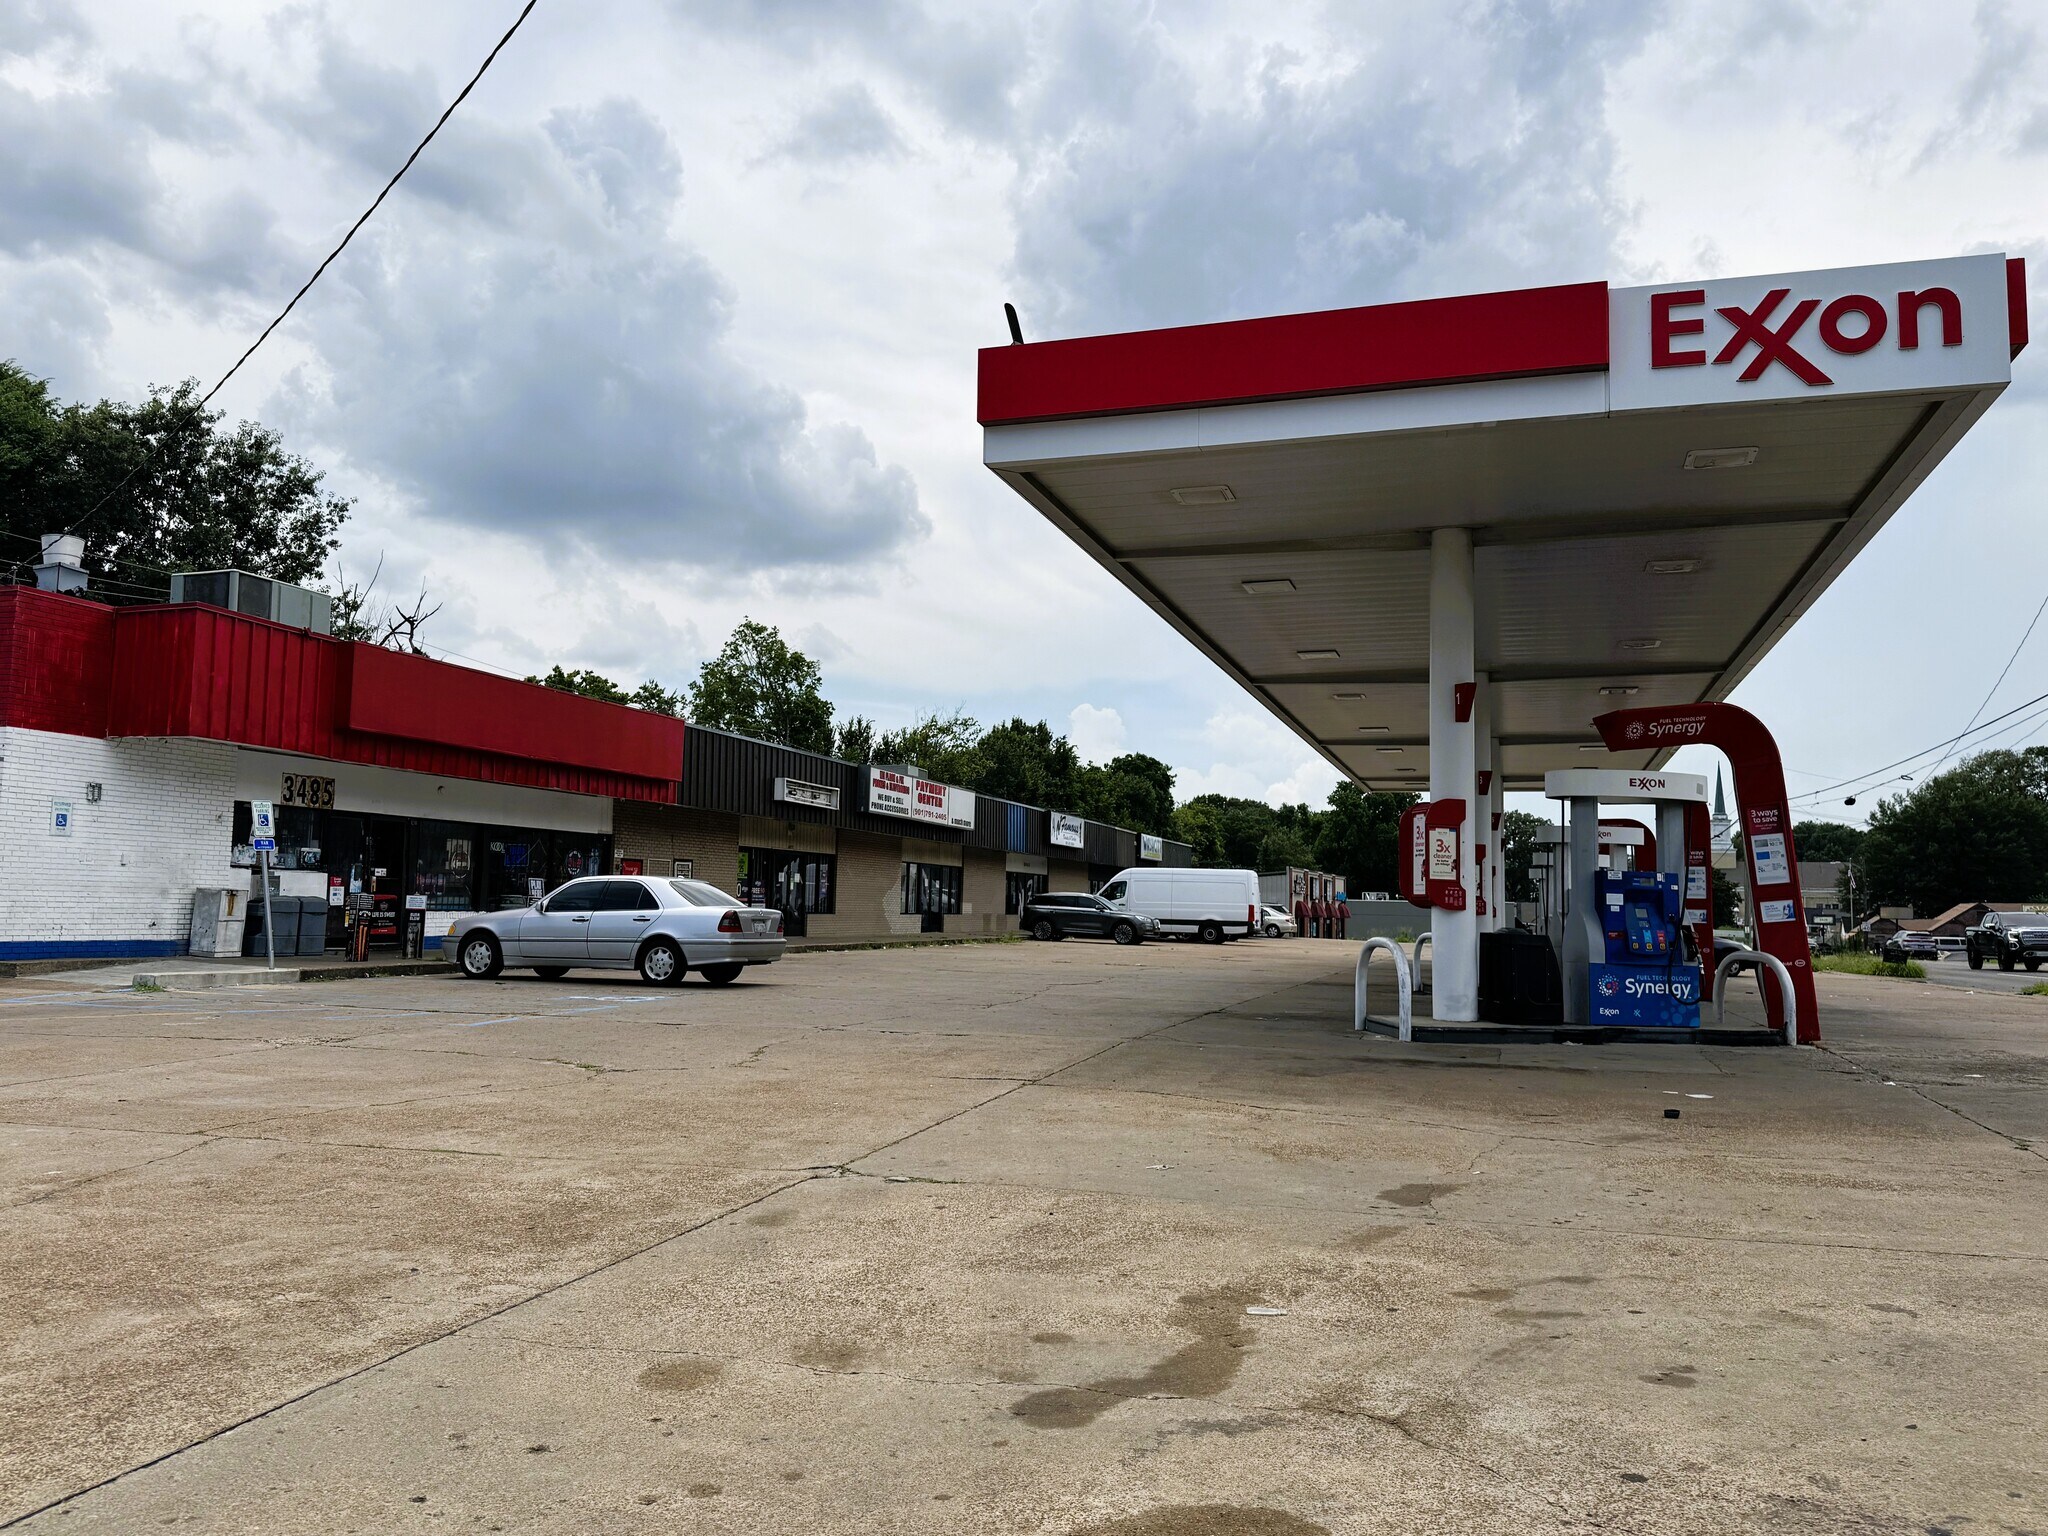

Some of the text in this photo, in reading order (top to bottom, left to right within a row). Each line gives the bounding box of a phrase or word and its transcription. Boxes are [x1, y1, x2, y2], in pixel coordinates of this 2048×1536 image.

[1651, 287, 1962, 386] Exxon
[1456, 693, 1460, 704] 1
[1648, 722, 1705, 738] Synergy
[282, 775, 333, 806] 3485
[916, 780, 946, 797] PAYMENT
[1629, 777, 1666, 791] EXXON
[877, 793, 884, 801] WE
[884, 794, 892, 803] BUY
[895, 797, 904, 805] SELL
[917, 793, 943, 808] CENTER
[871, 801, 909, 815] PHONE ACCESSORIES
[1756, 809, 1778, 817] ways
[1416, 826, 1424, 840] 3x
[1436, 839, 1451, 853] 3x
[1600, 1008, 1619, 1017] Exxon
